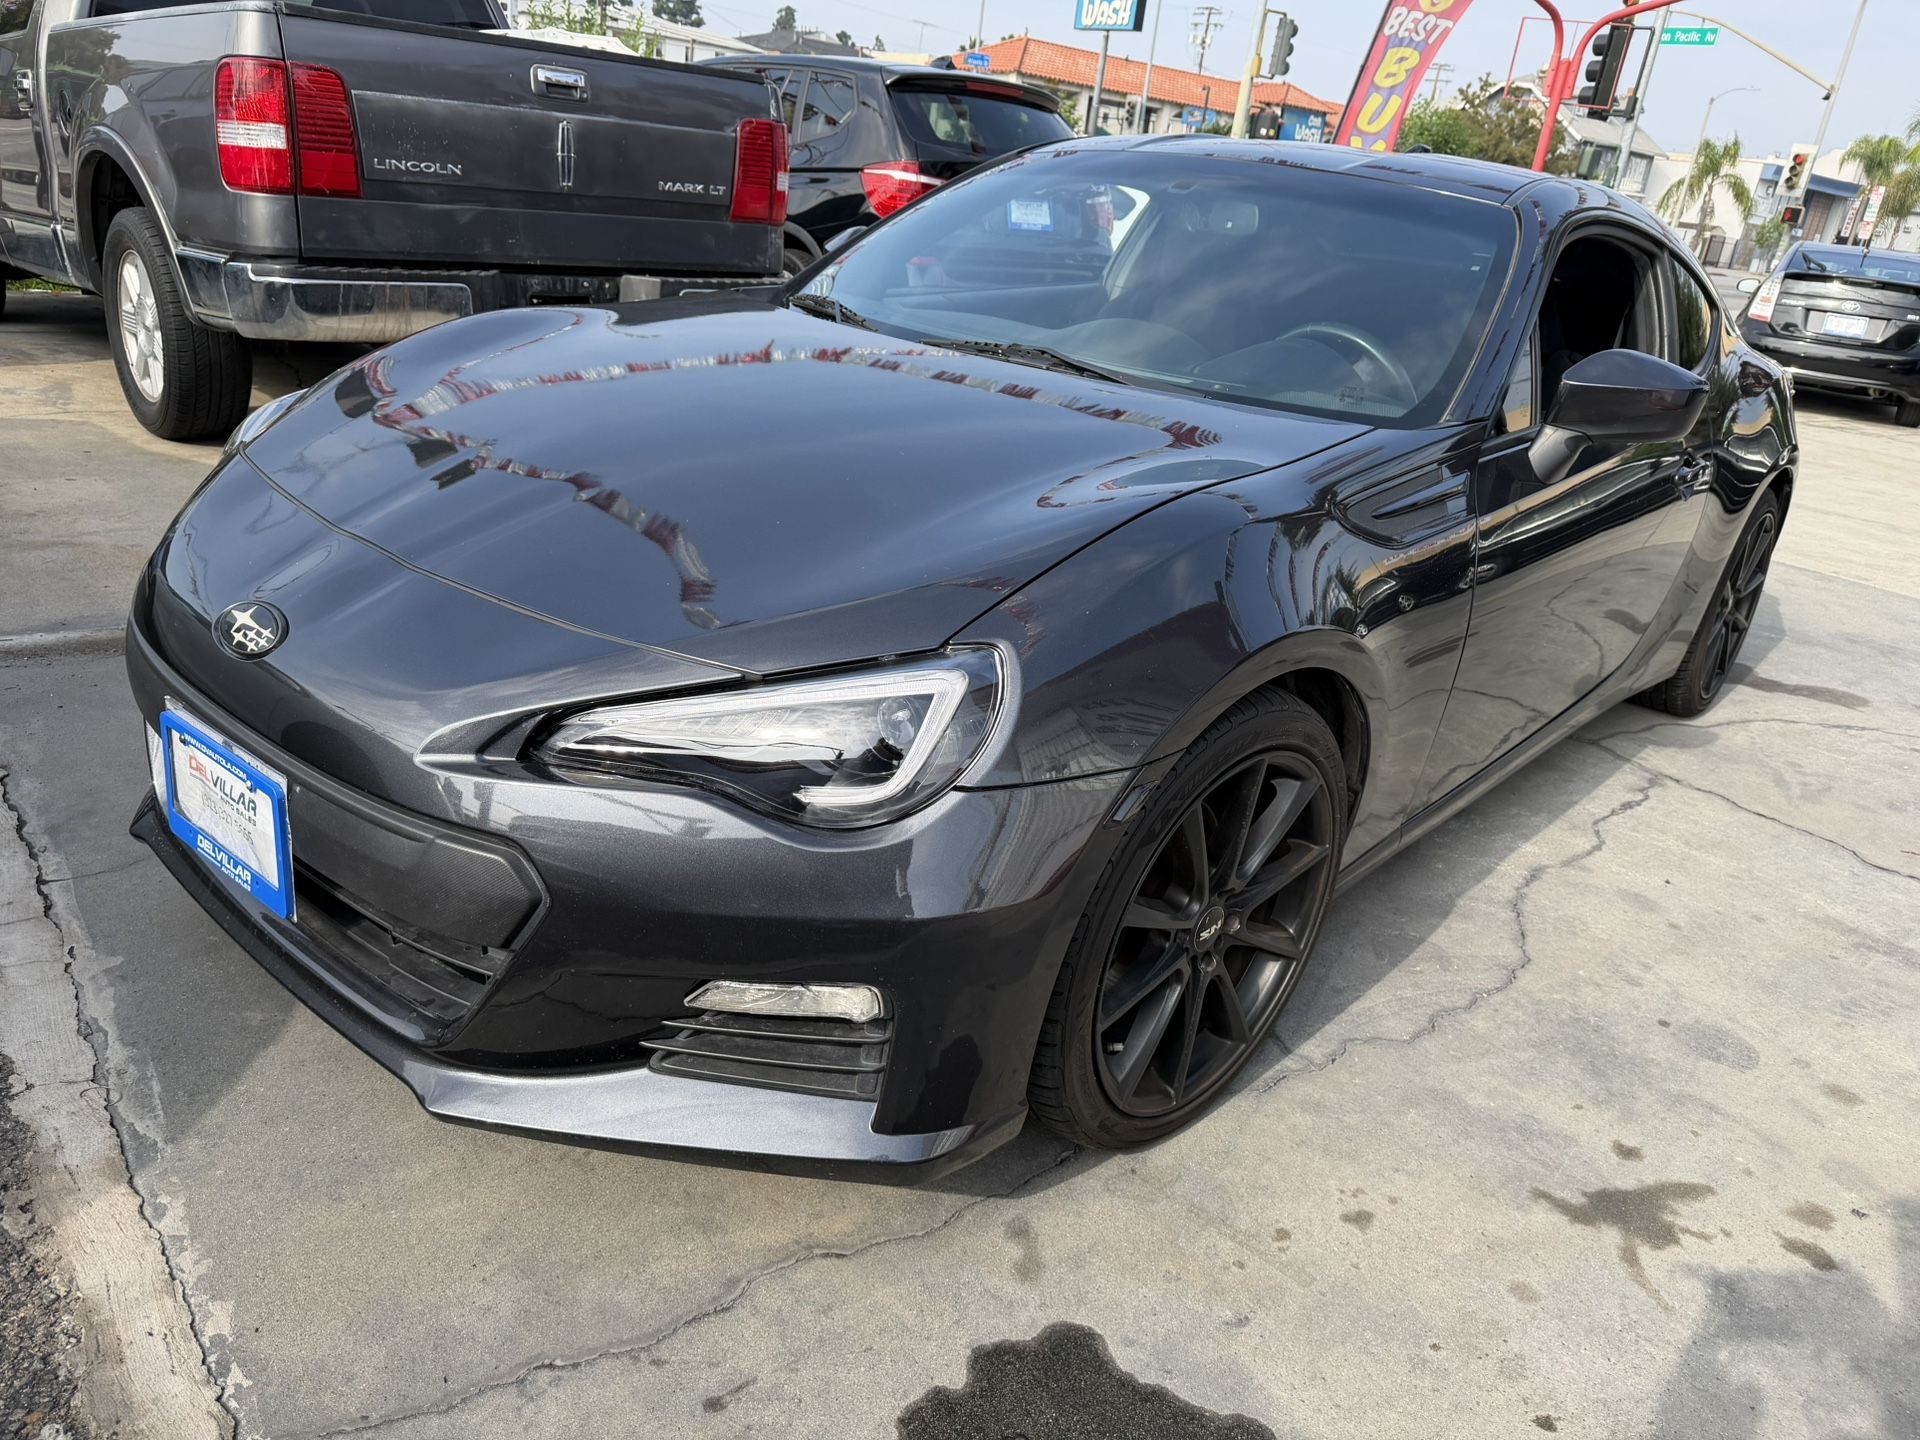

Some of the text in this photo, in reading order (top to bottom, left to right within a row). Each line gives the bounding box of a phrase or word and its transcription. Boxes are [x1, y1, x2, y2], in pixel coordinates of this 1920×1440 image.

[1081, 0, 1133, 26] WASH
[1383, 6, 1453, 45] BEST
[1674, 31, 1702, 42] Pacific
[1704, 32, 1716, 42] Av
[373, 158, 463, 176] LINCOLN
[658, 181, 727, 195] MARK LT
[235, 807, 257, 827] SALES
[197, 833, 252, 885] DELVILLAR
[221, 865, 251, 892] AUTO SALES
